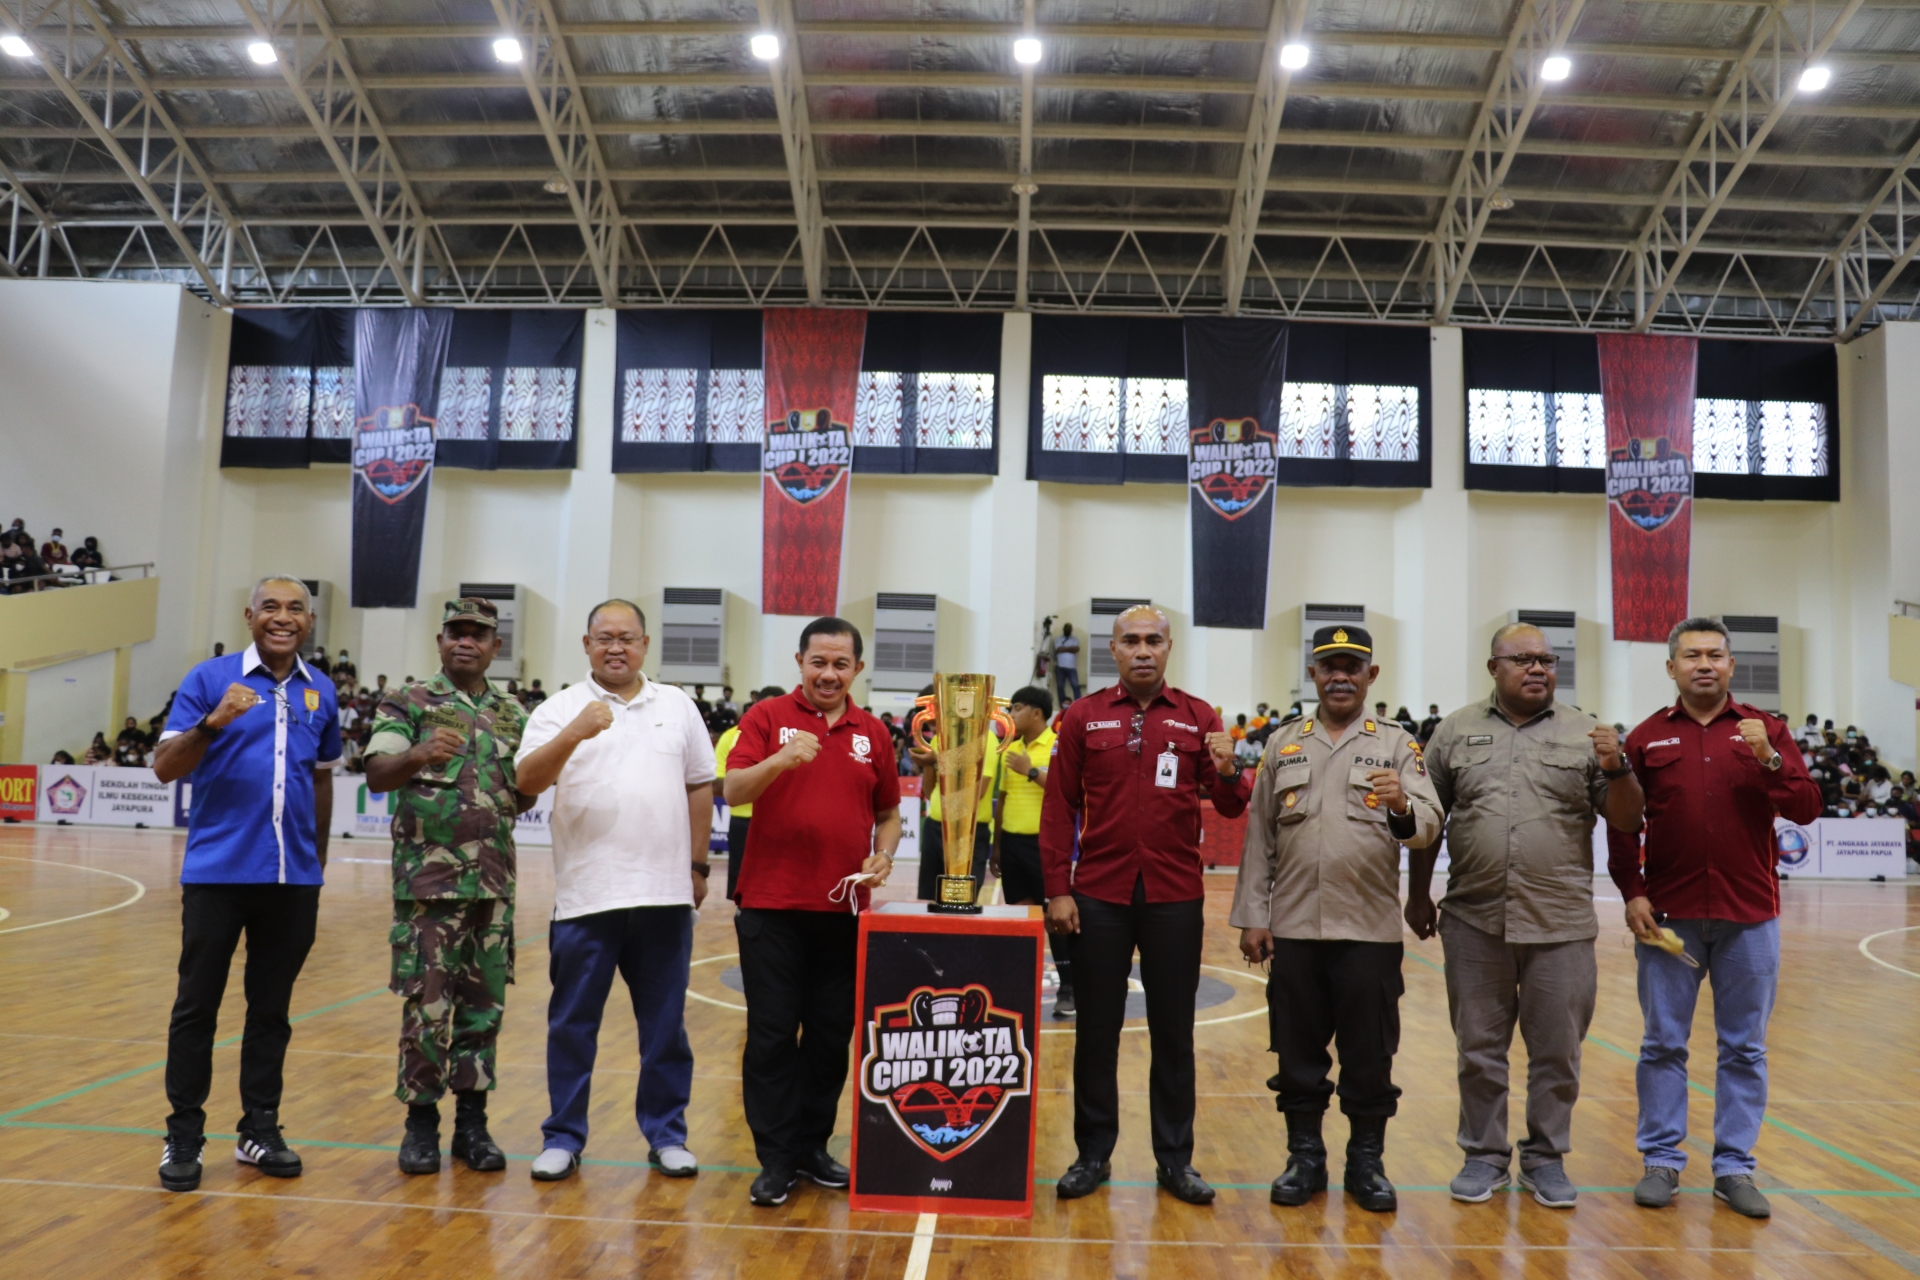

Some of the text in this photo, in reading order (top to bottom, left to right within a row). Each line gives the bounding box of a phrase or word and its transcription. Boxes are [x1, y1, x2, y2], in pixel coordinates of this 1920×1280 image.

[360, 427, 432, 448] WALIKOTA
[769, 430, 846, 451] WALIKOTA
[355, 447, 385, 467] CUP
[395, 443, 435, 462] 2022
[764, 450, 796, 469] CUP
[807, 447, 849, 466] 2022
[1194, 442, 1271, 461] WALIKOTA
[1190, 461, 1222, 480] CUP
[1233, 458, 1275, 477] 2022
[1611, 459, 1685, 478] WALIKOTA
[1608, 478, 1639, 497] CUP
[1650, 475, 1689, 494] 2022
[1277, 756, 1308, 768] RUMRA
[1354, 756, 1394, 769] POLRI
[0, 777, 35, 802] ORT
[100, 780, 169, 790] SEKOLAH TINGGI
[98, 792, 169, 801] ILMU KESEHATAN
[112, 804, 154, 813] JAYAPURA
[881, 1027, 1013, 1061] WALIKOTA
[872, 1059, 928, 1091] CUP
[948, 1054, 1019, 1087] 2022
